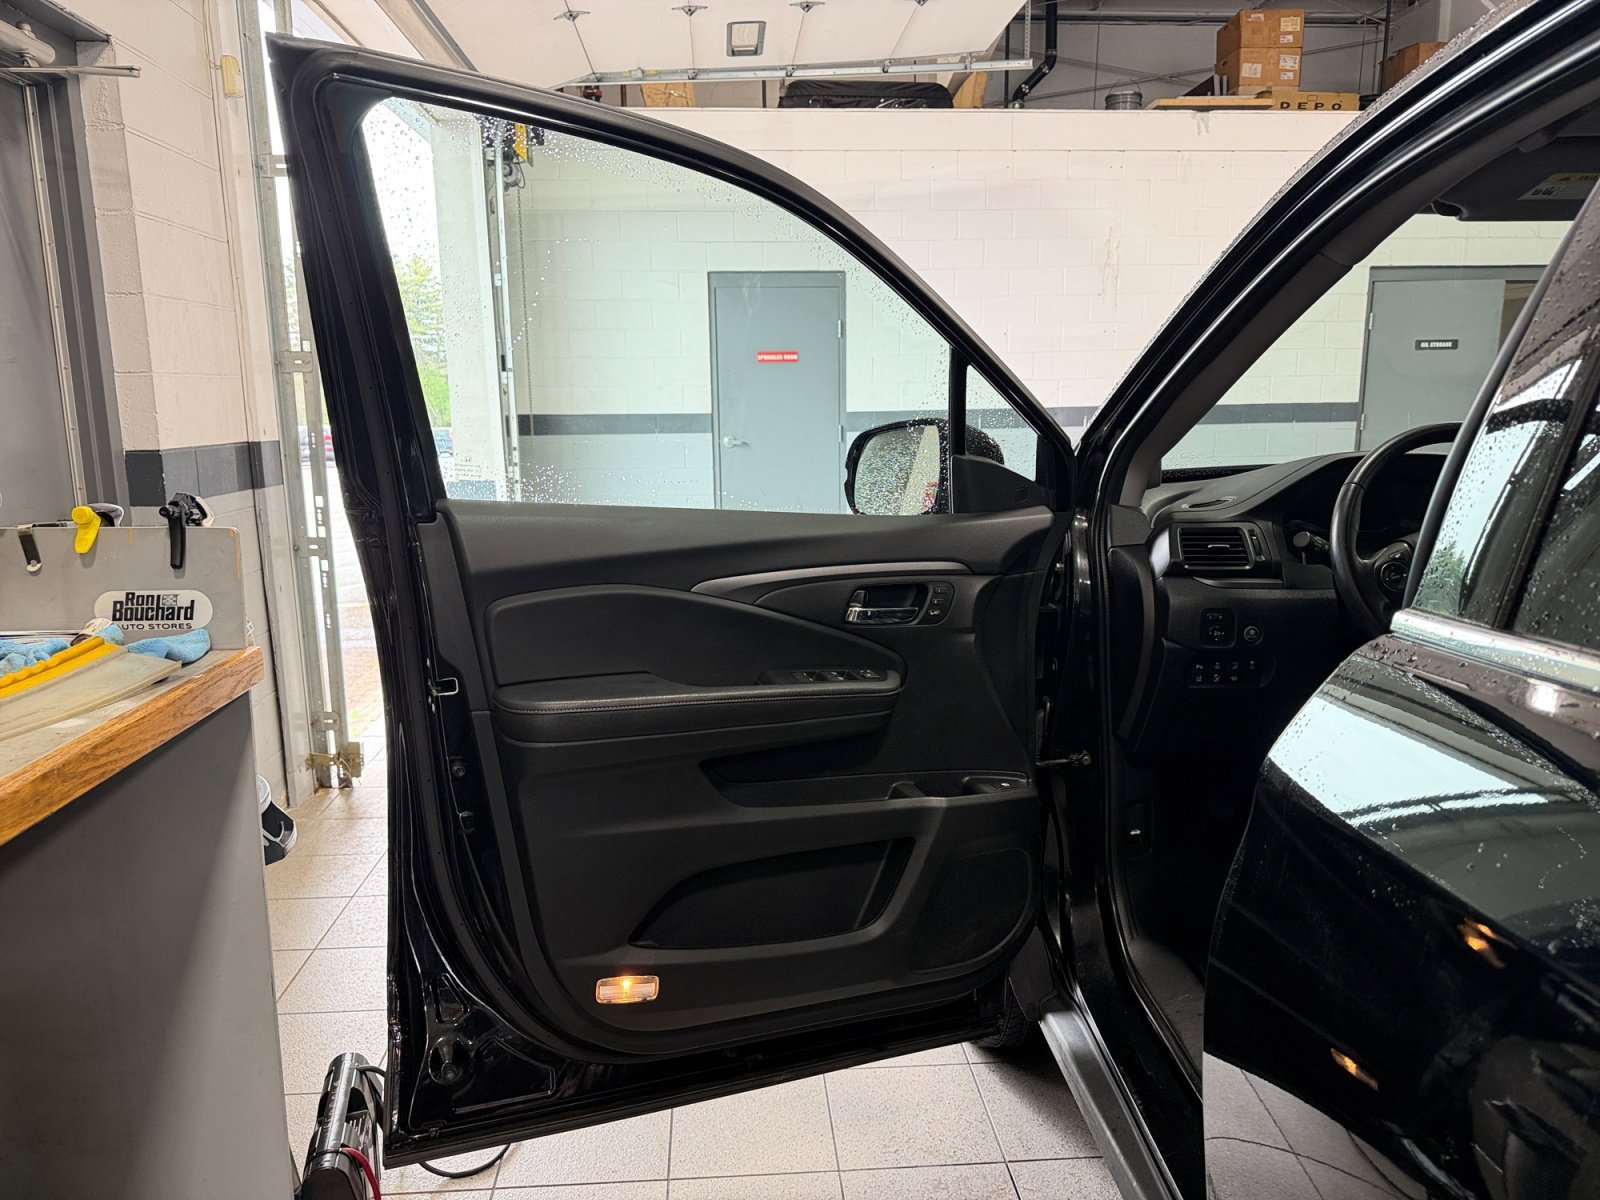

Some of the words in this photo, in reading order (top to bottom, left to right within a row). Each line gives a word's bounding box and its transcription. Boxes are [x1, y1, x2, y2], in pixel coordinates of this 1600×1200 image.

[1280, 101, 1342, 110] DEPO
[125, 592, 155, 606] Ron
[112, 594, 195, 622] Bouchard
[148, 622, 193, 630] STORES
